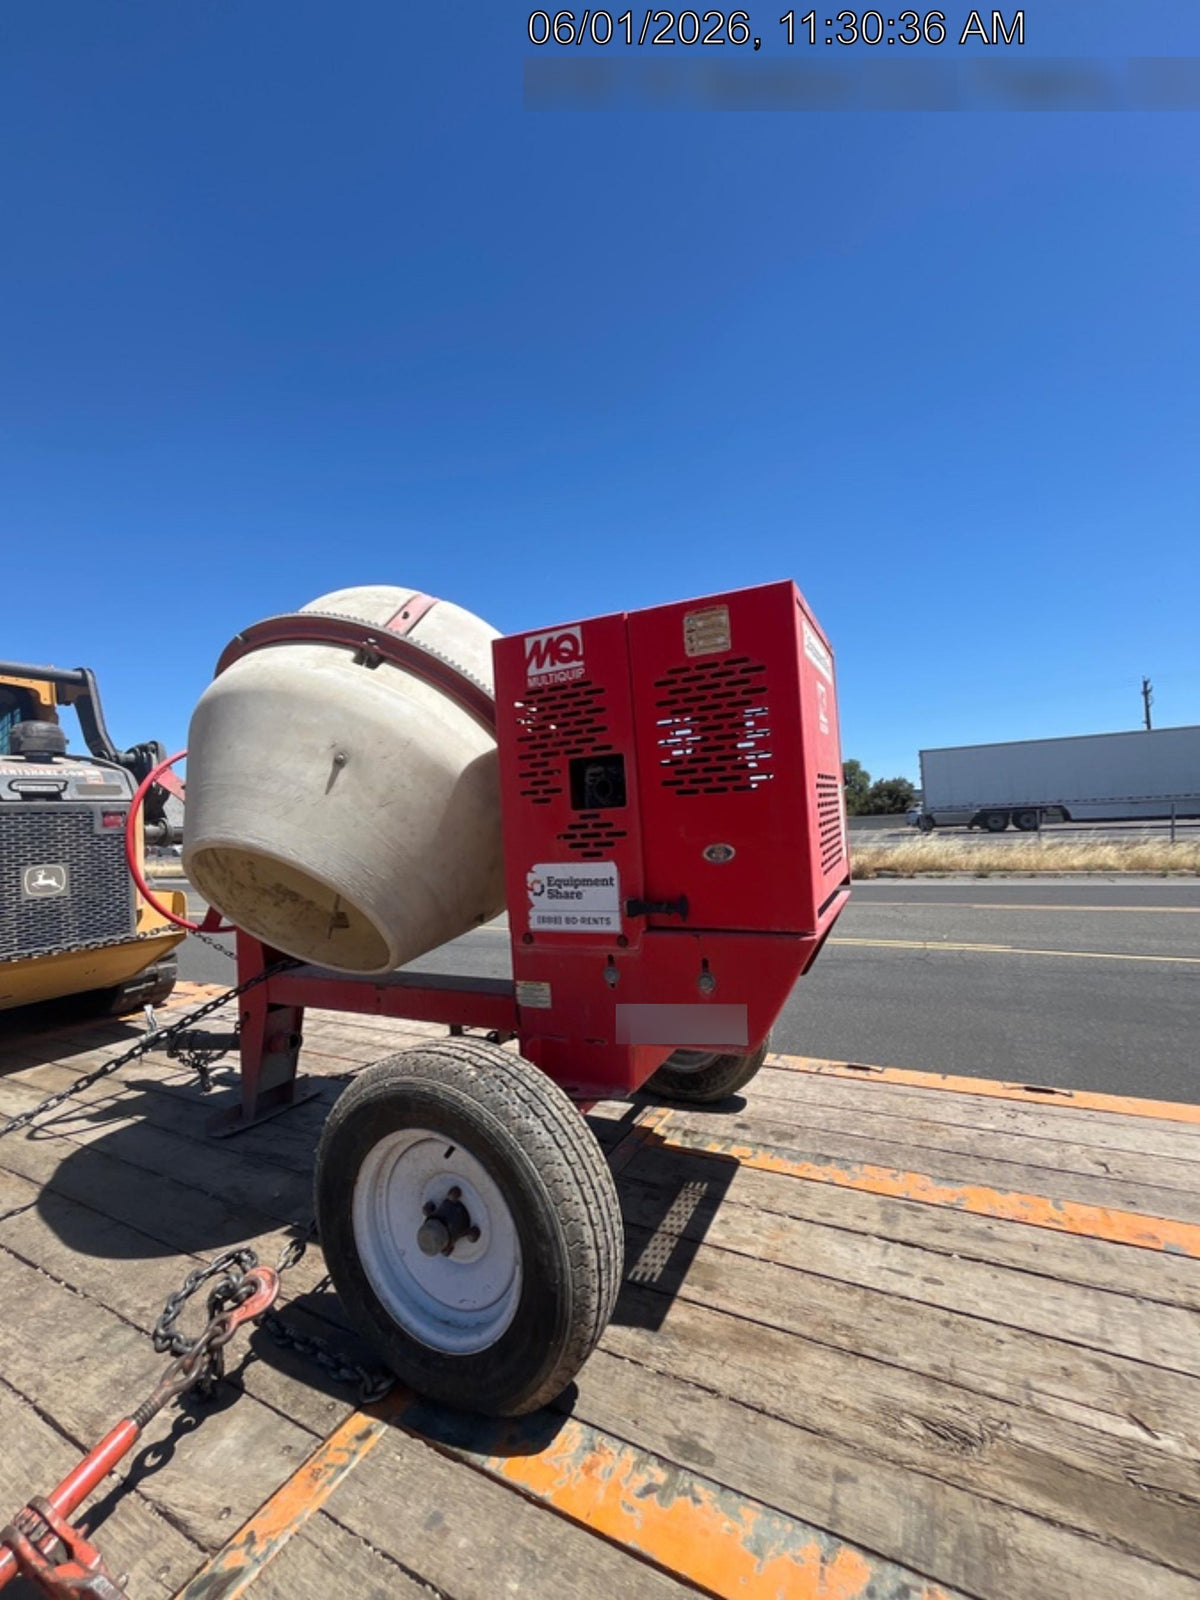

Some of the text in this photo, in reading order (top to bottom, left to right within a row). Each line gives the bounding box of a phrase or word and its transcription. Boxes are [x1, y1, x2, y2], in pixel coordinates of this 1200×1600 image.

[526, 633, 584, 669] MQ
[527, 667, 585, 688] MULTIQUIP
[546, 876, 615, 889] Equipment
[547, 888, 583, 900] Share
